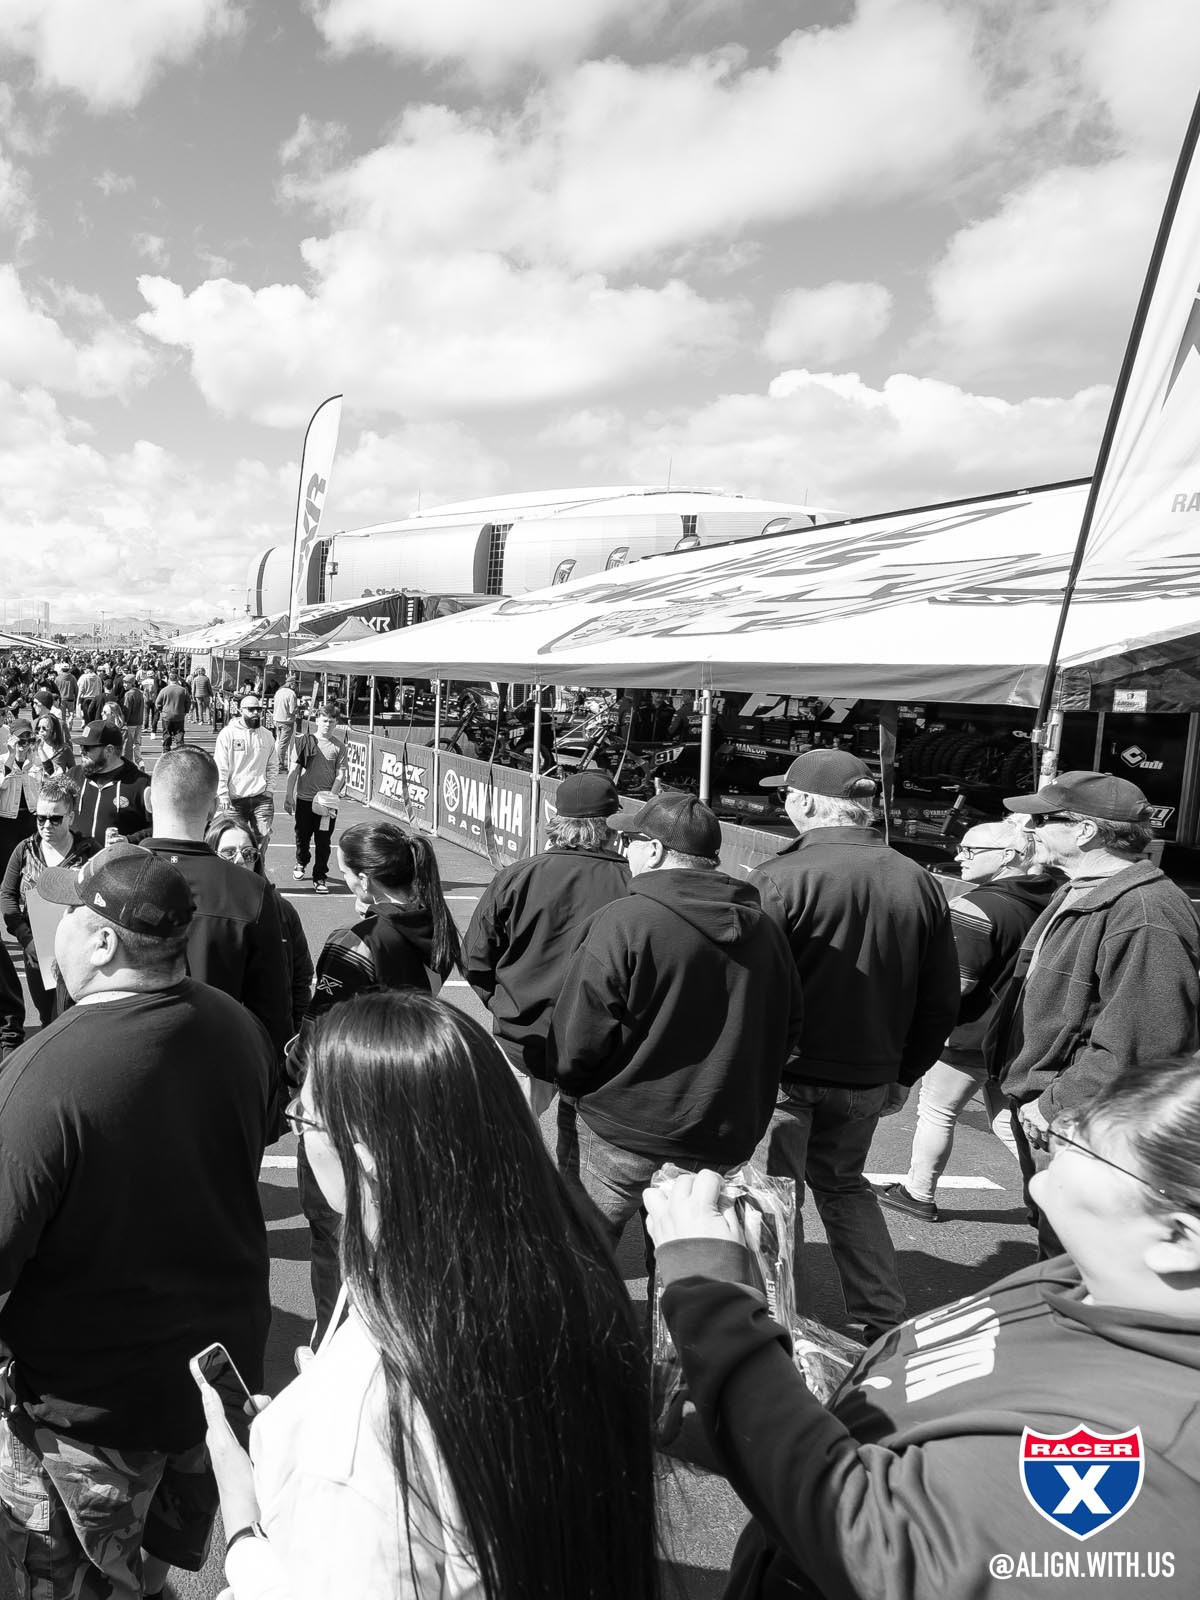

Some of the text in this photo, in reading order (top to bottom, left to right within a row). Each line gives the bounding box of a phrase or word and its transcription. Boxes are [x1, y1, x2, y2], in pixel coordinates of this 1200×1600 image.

[380, 750, 427, 784] ROCK
[655, 750, 674, 765] 91
[448, 815, 517, 851] RACNG
